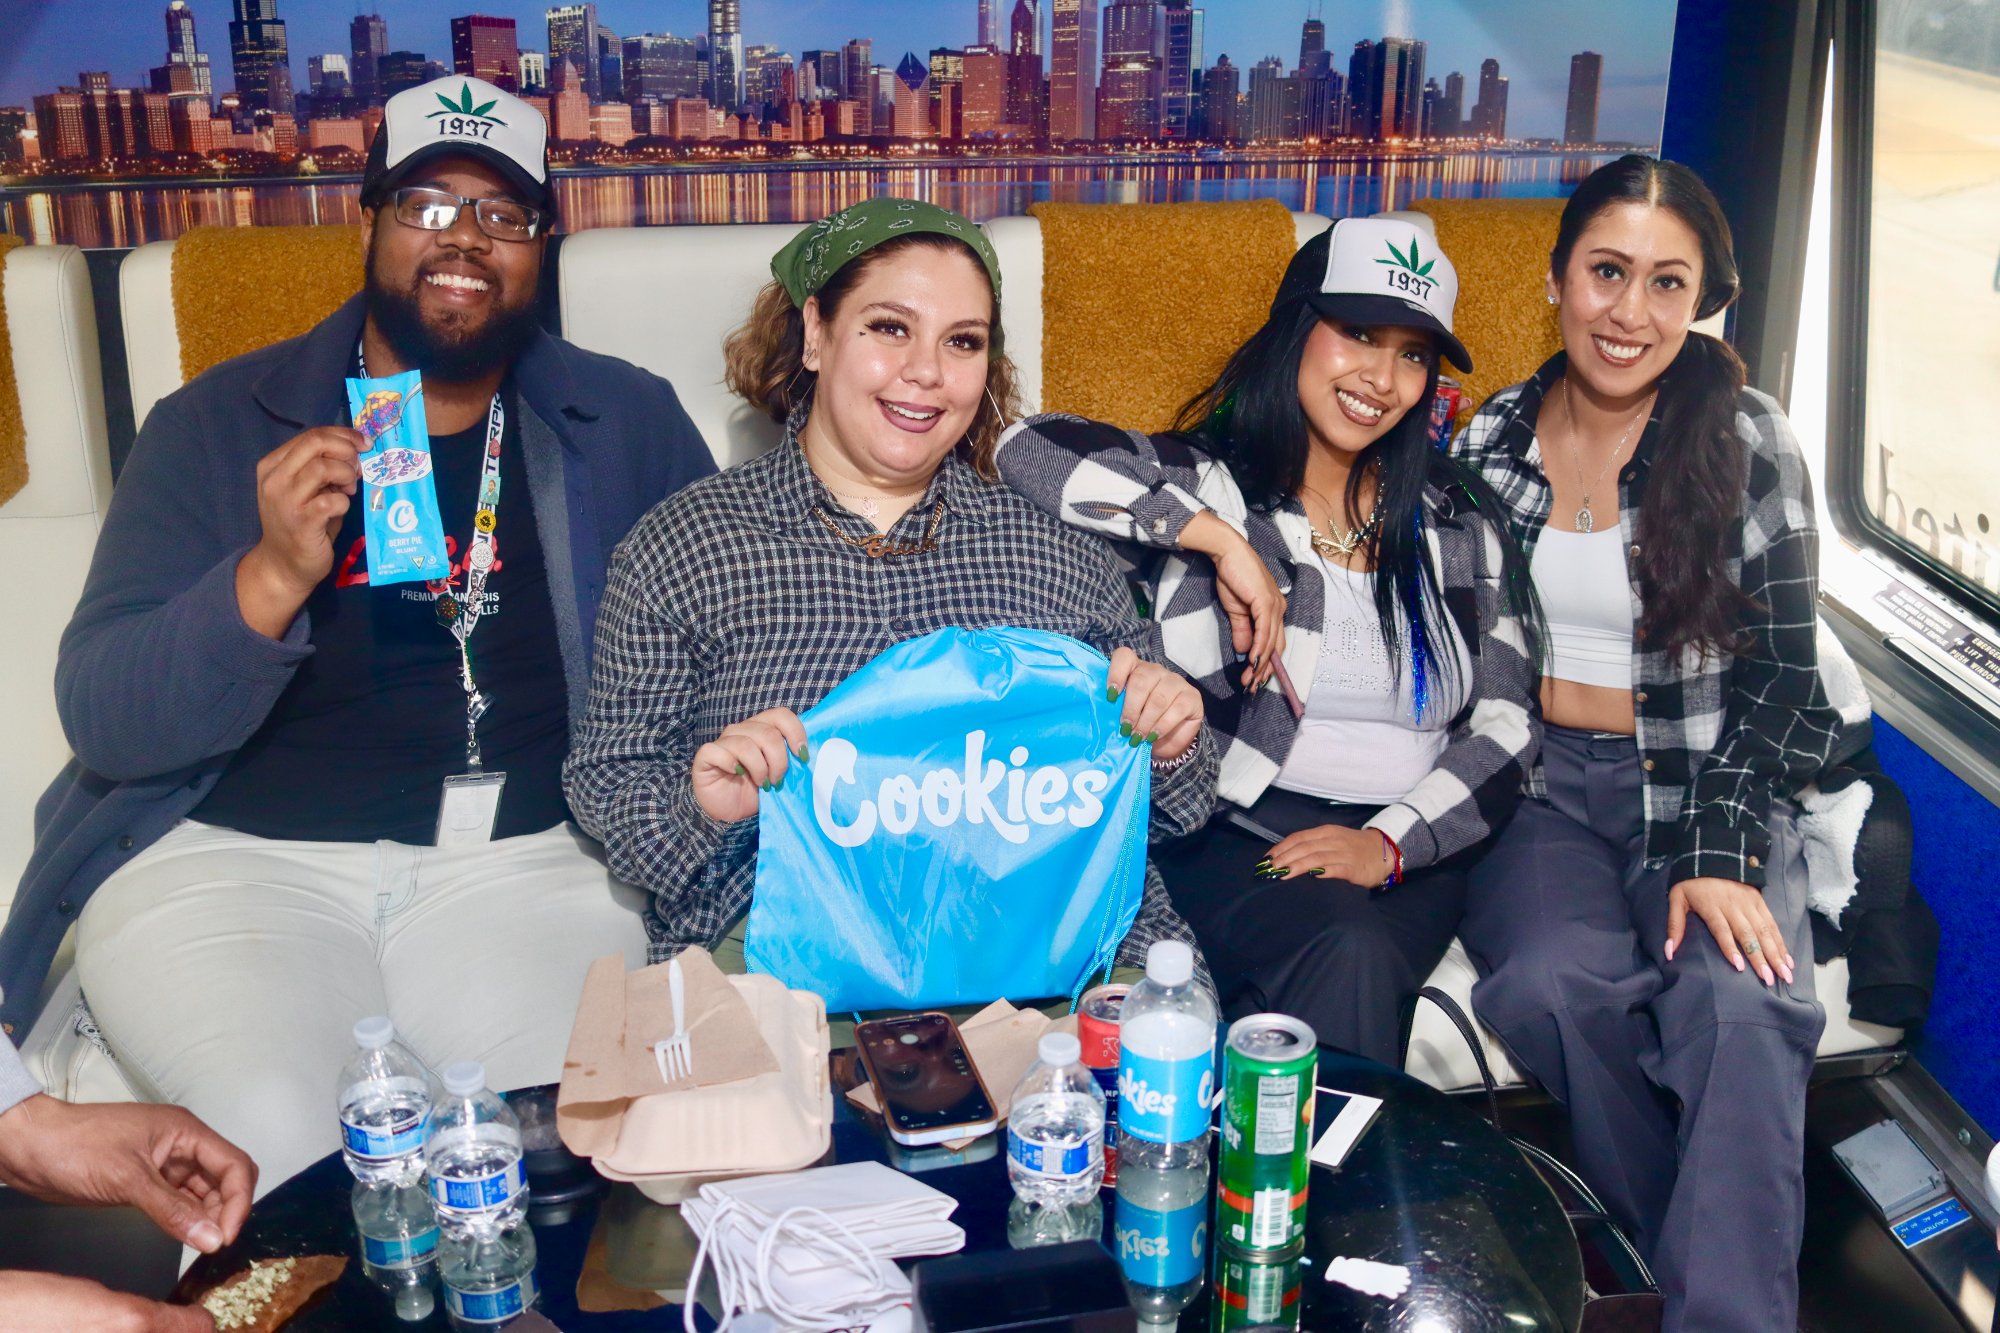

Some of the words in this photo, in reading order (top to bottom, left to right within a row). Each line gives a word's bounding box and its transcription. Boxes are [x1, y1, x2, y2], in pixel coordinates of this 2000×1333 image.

[439, 117, 494, 140] 1937
[1388, 269, 1432, 300] 1937
[388, 538, 410, 548] BERRY
[411, 536, 423, 545] PIE
[1964, 646, 1983, 660] LIFT
[1949, 649, 1970, 665] PUSH
[1970, 662, 2000, 684] WINDOW
[812, 729, 1109, 848] Cookies
[1920, 1218, 1949, 1234] CAUTION
